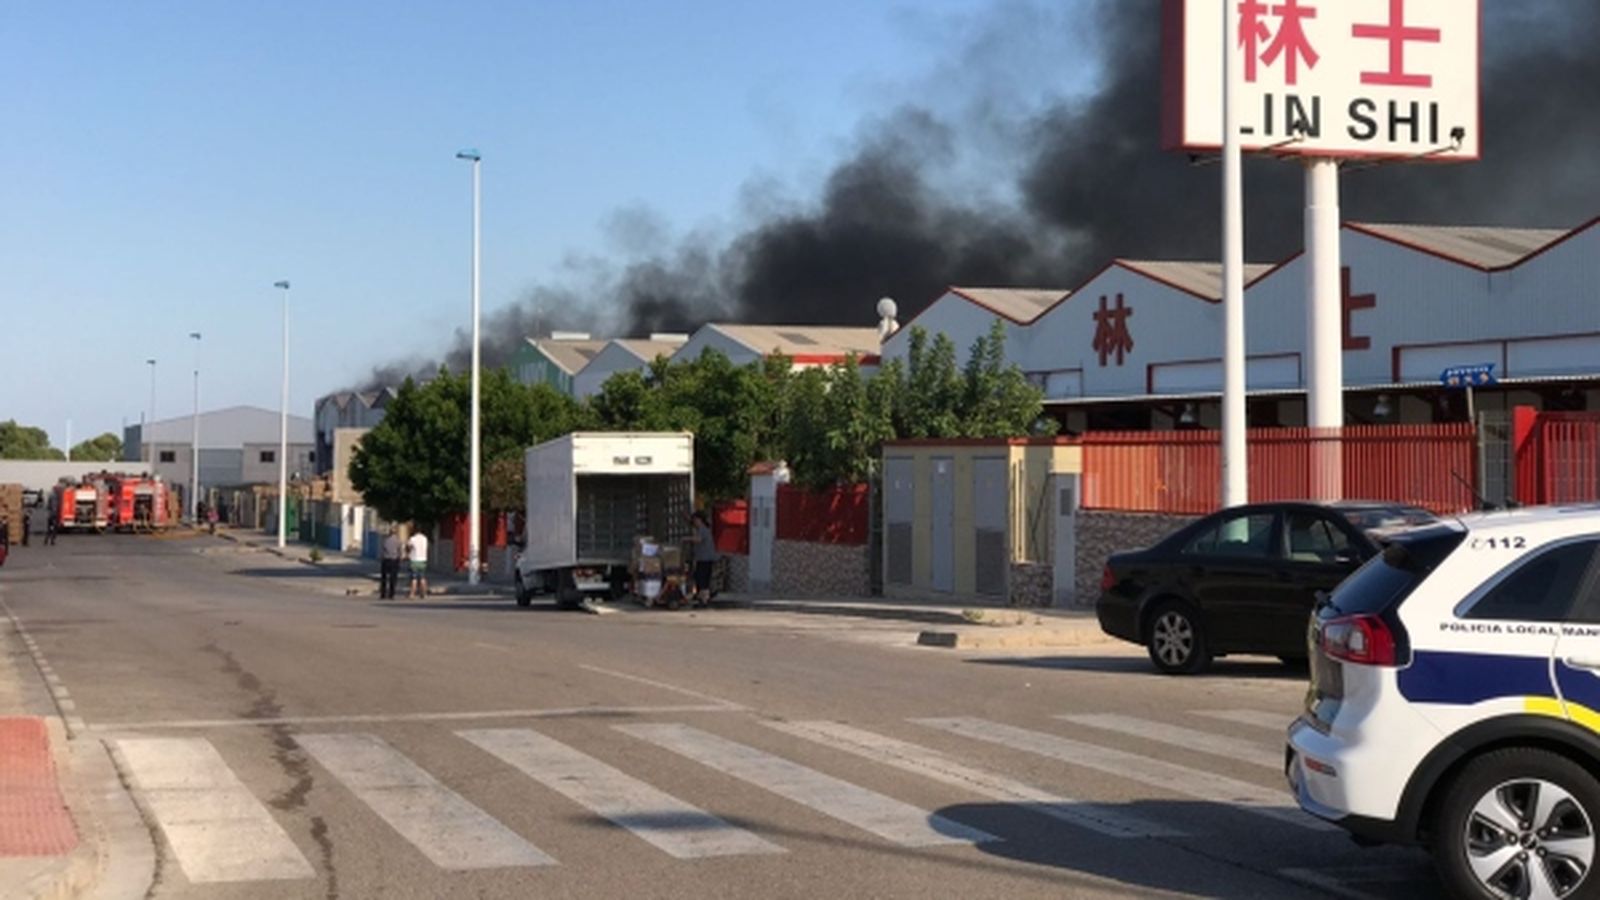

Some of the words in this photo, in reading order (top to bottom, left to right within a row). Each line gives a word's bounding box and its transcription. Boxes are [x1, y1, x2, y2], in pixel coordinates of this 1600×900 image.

[1240, 93, 1320, 138] IN
[1347, 98, 1438, 144] SHI
[1092, 293, 1134, 367] 林
[1486, 536, 1526, 549] 112
[1440, 623, 1502, 634] POLICIA
[1506, 625, 1559, 635] LOCAL
